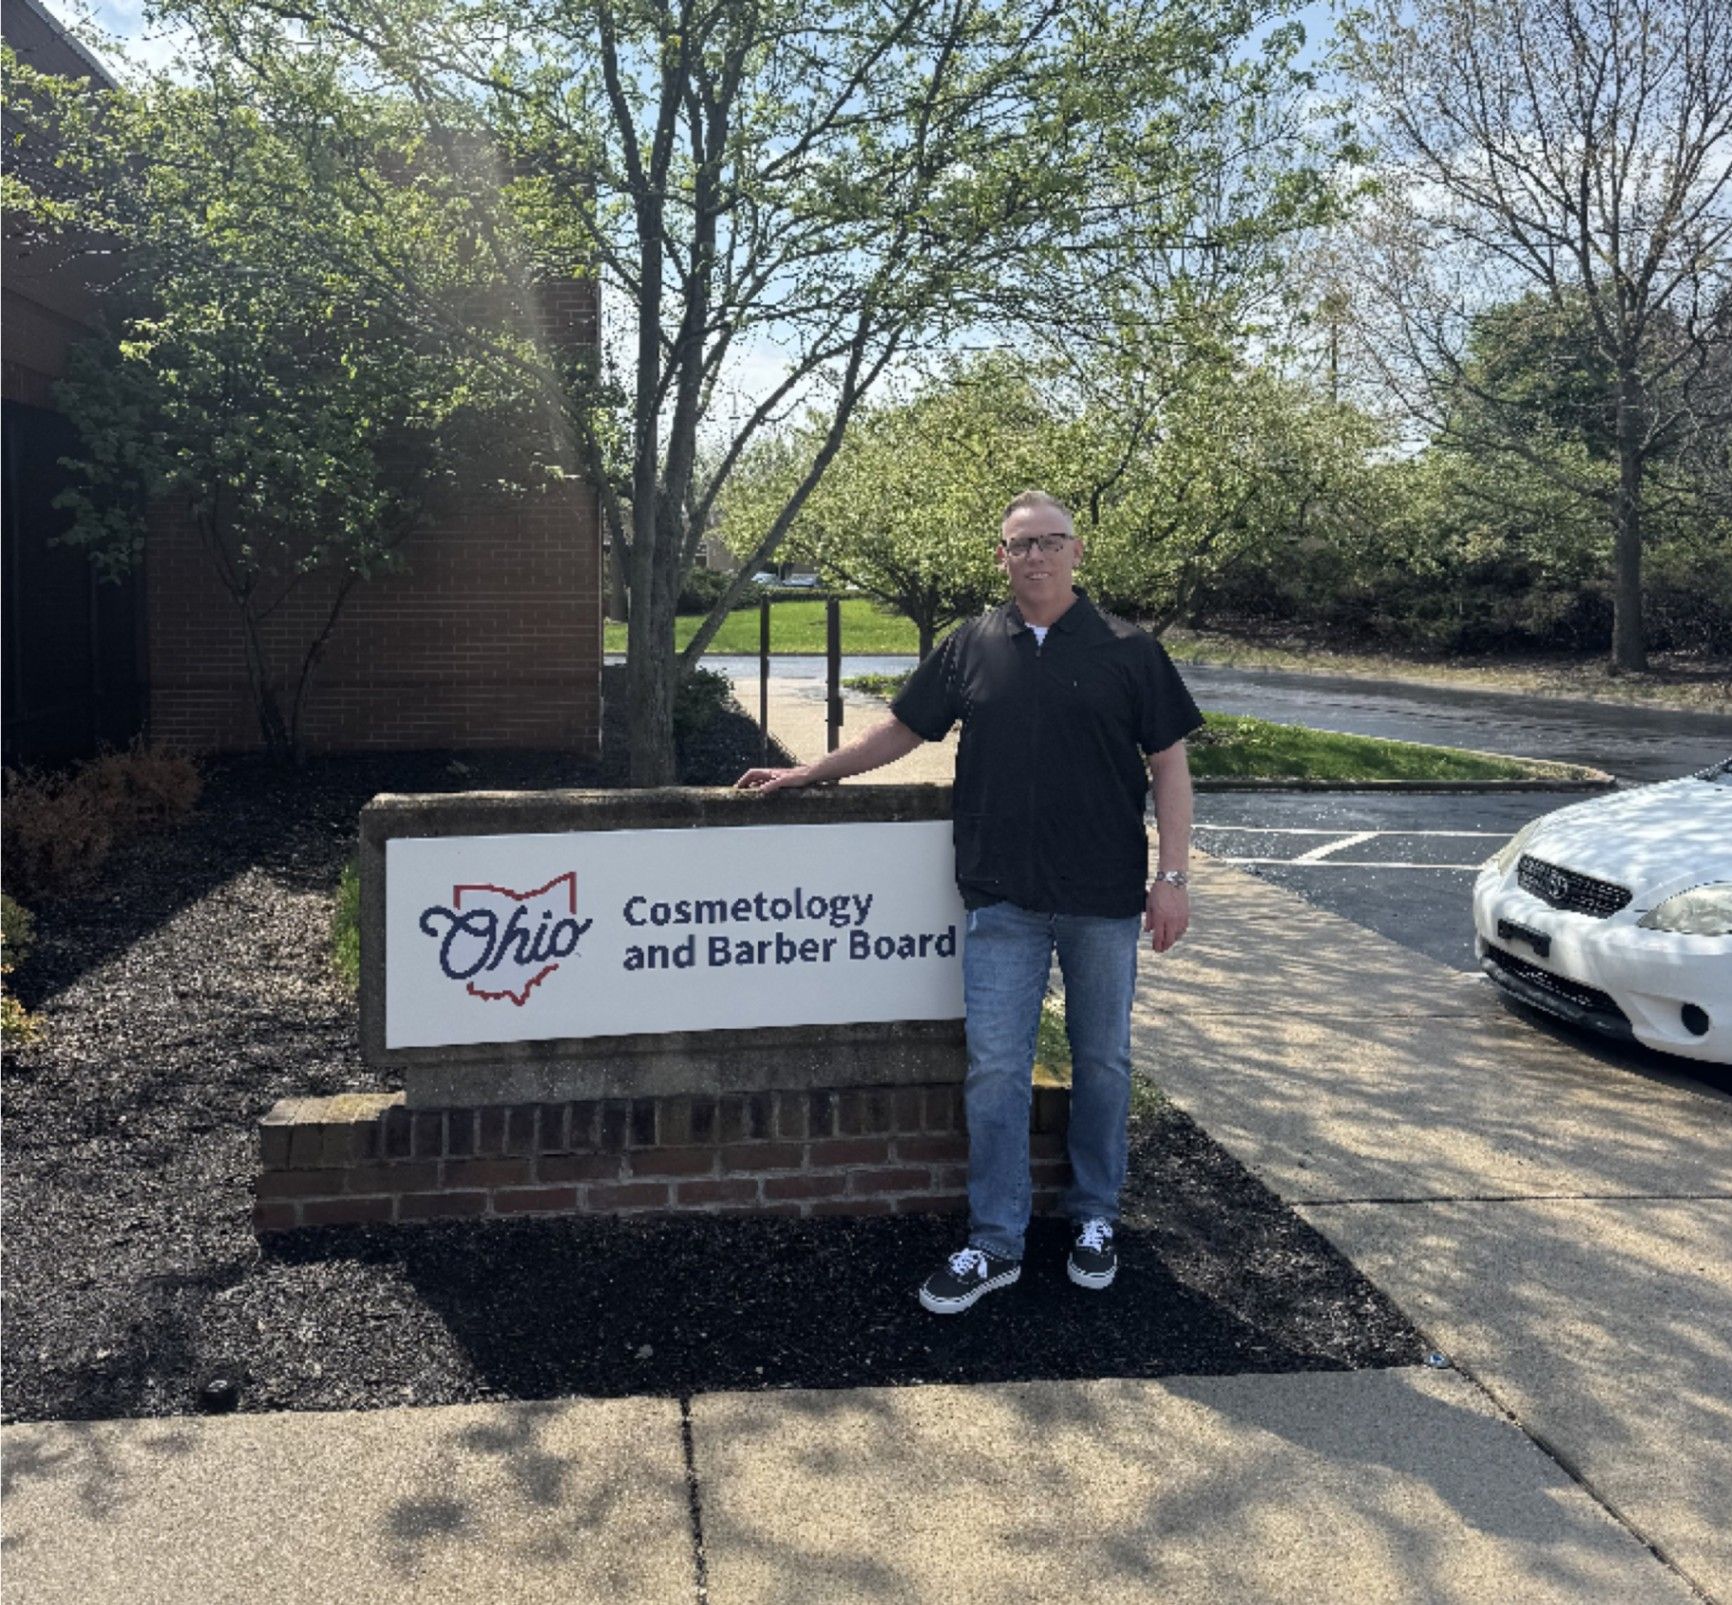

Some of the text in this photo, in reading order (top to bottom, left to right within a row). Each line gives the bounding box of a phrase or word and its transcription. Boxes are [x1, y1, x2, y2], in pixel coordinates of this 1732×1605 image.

[622, 886, 874, 928] Cosmetology
[418, 904, 594, 981] Ohio
[622, 926, 957, 972] and Barber Board
